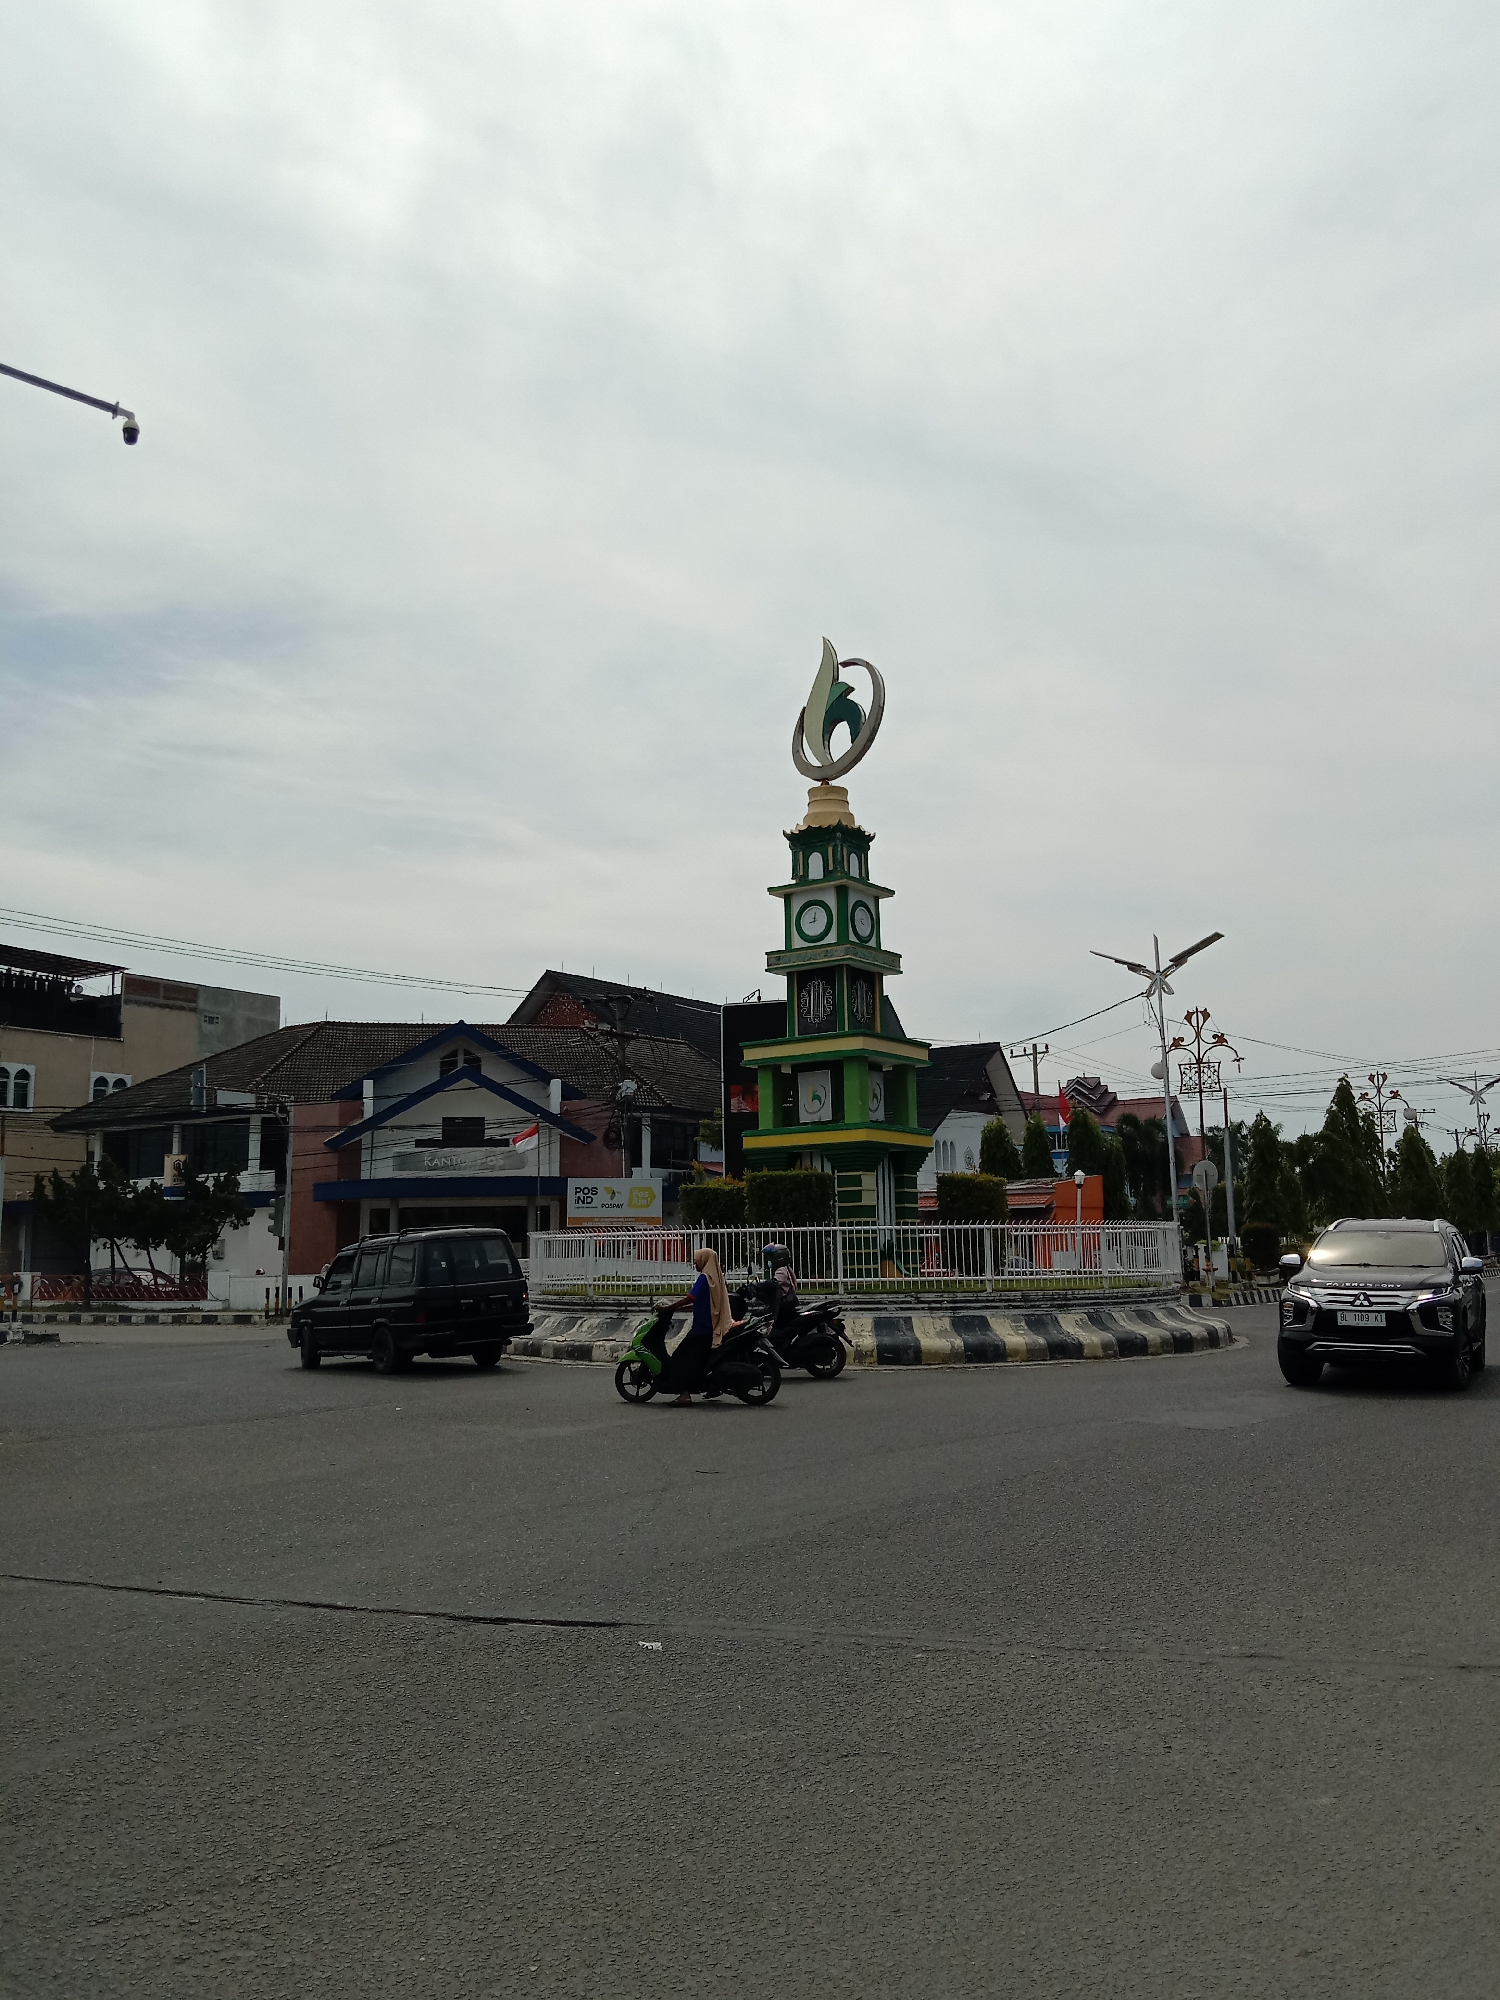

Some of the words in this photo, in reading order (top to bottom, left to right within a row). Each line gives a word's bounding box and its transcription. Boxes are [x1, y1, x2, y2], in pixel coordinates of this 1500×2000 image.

[477, 1156, 504, 1166] POS
[574, 1187, 598, 1196] POS
[1354, 1314, 1369, 1322] 1109
